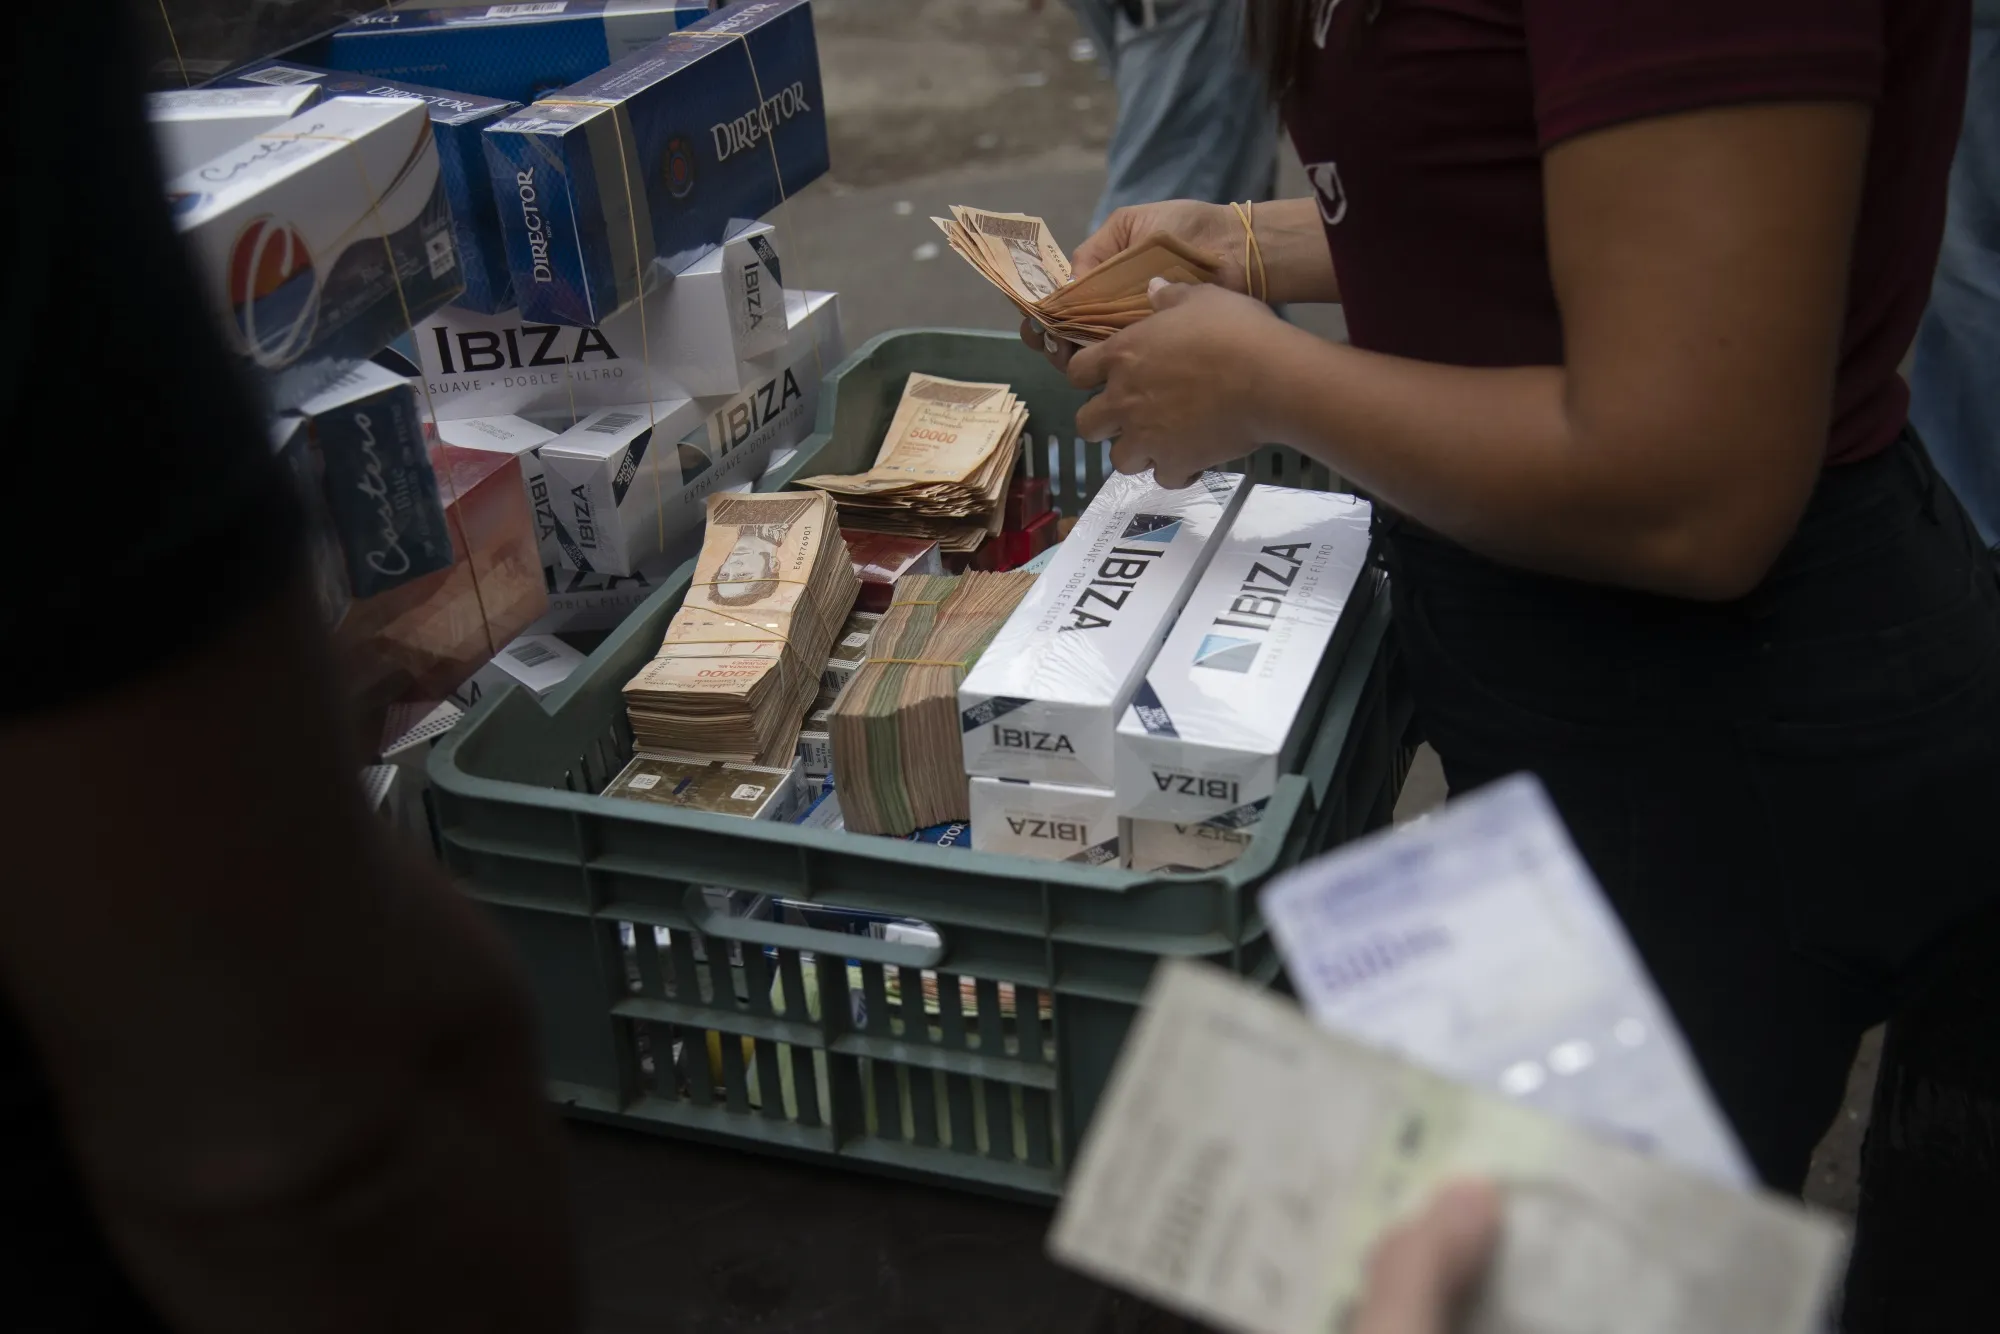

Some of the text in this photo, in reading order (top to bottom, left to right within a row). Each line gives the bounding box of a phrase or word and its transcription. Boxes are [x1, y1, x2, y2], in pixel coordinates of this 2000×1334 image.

[711, 80, 811, 162] DIRECTOR
[517, 167, 552, 284] DIRECTOR
[743, 261, 764, 330] IBIZA
[431, 322, 620, 375] IBIZA
[428, 379, 482, 395] SUAVE
[504, 368, 559, 388] DOBLE
[714, 366, 802, 458] IBIZA
[909, 427, 958, 444] 50000
[616, 453, 634, 485] SHORT
[623, 463, 637, 487] SIZE
[684, 476, 712, 504] EXTRA
[714, 453, 741, 485] SUAVE
[529, 473, 554, 542] IBIZA
[572, 484, 597, 550] IBIZA
[1083, 537, 1109, 564] SUAVE
[1310, 543, 1334, 574] FILTRO
[1058, 572, 1085, 600] DOBLE
[1058, 545, 1165, 633] IBIZA
[1212, 542, 1312, 631] IBIZA
[697, 669, 760, 678] 50000
[993, 724, 1075, 754] IBIZA
[1152, 771, 1240, 804] IBIZA
[1006, 816, 1088, 846] IBIZA
